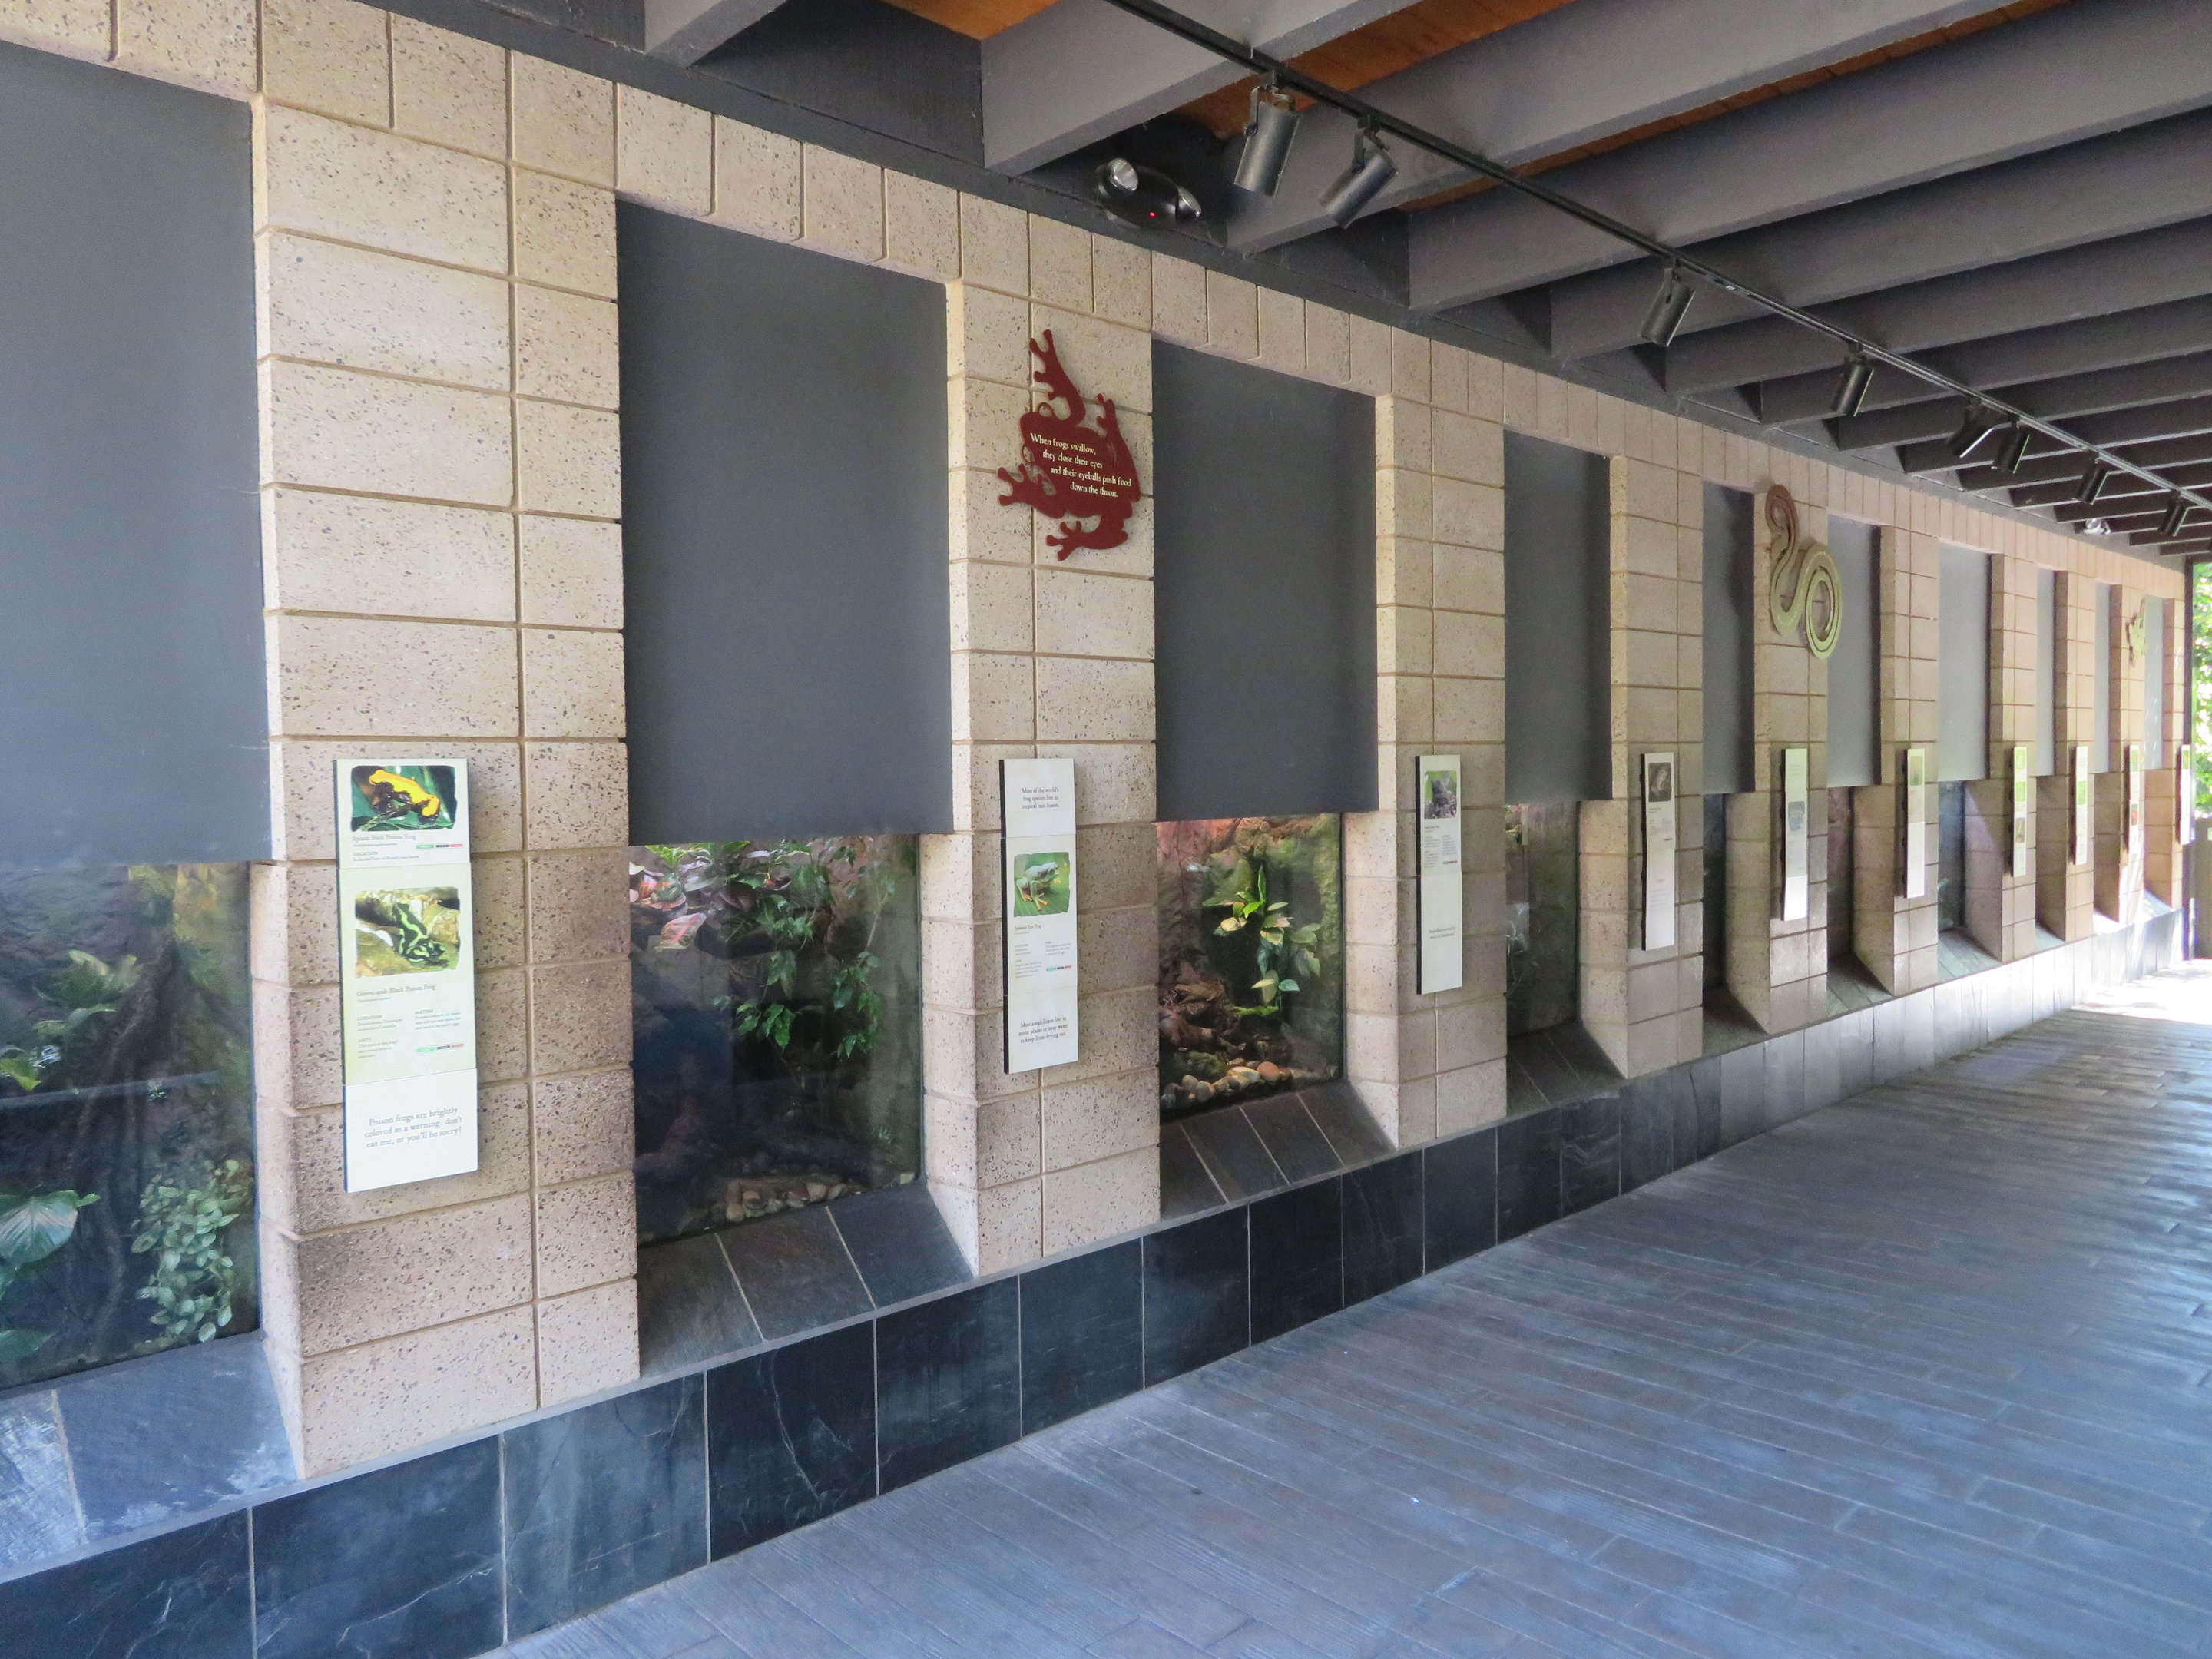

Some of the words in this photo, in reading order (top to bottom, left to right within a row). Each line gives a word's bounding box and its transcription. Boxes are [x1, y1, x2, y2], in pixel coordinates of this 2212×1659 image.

[1030, 432, 1051, 445] When
[1052, 438, 1069, 451] frogs
[1071, 443, 1096, 455] swallow,
[1042, 449, 1056, 462] they
[1058, 452, 1073, 463] close
[1074, 455, 1088, 466] their
[1090, 461, 1103, 469] eyes
[1050, 465, 1061, 475] and
[1062, 467, 1077, 478] their
[1078, 471, 1101, 482] eyeballs
[1102, 475, 1116, 485] push
[1118, 477, 1131, 487] food
[1070, 482, 1088, 492] down
[1088, 485, 1098, 495] the
[1099, 487, 1118, 498] throat.
[369, 1118, 394, 1126] Poison
[396, 1114, 414, 1123] frogs
[429, 1106, 459, 1118] brightly
[364, 1127, 392, 1137] colored
[444, 1116, 462, 1125] don't
[406, 1131, 428, 1144] you'll
[439, 1126, 462, 1137] sorry!
